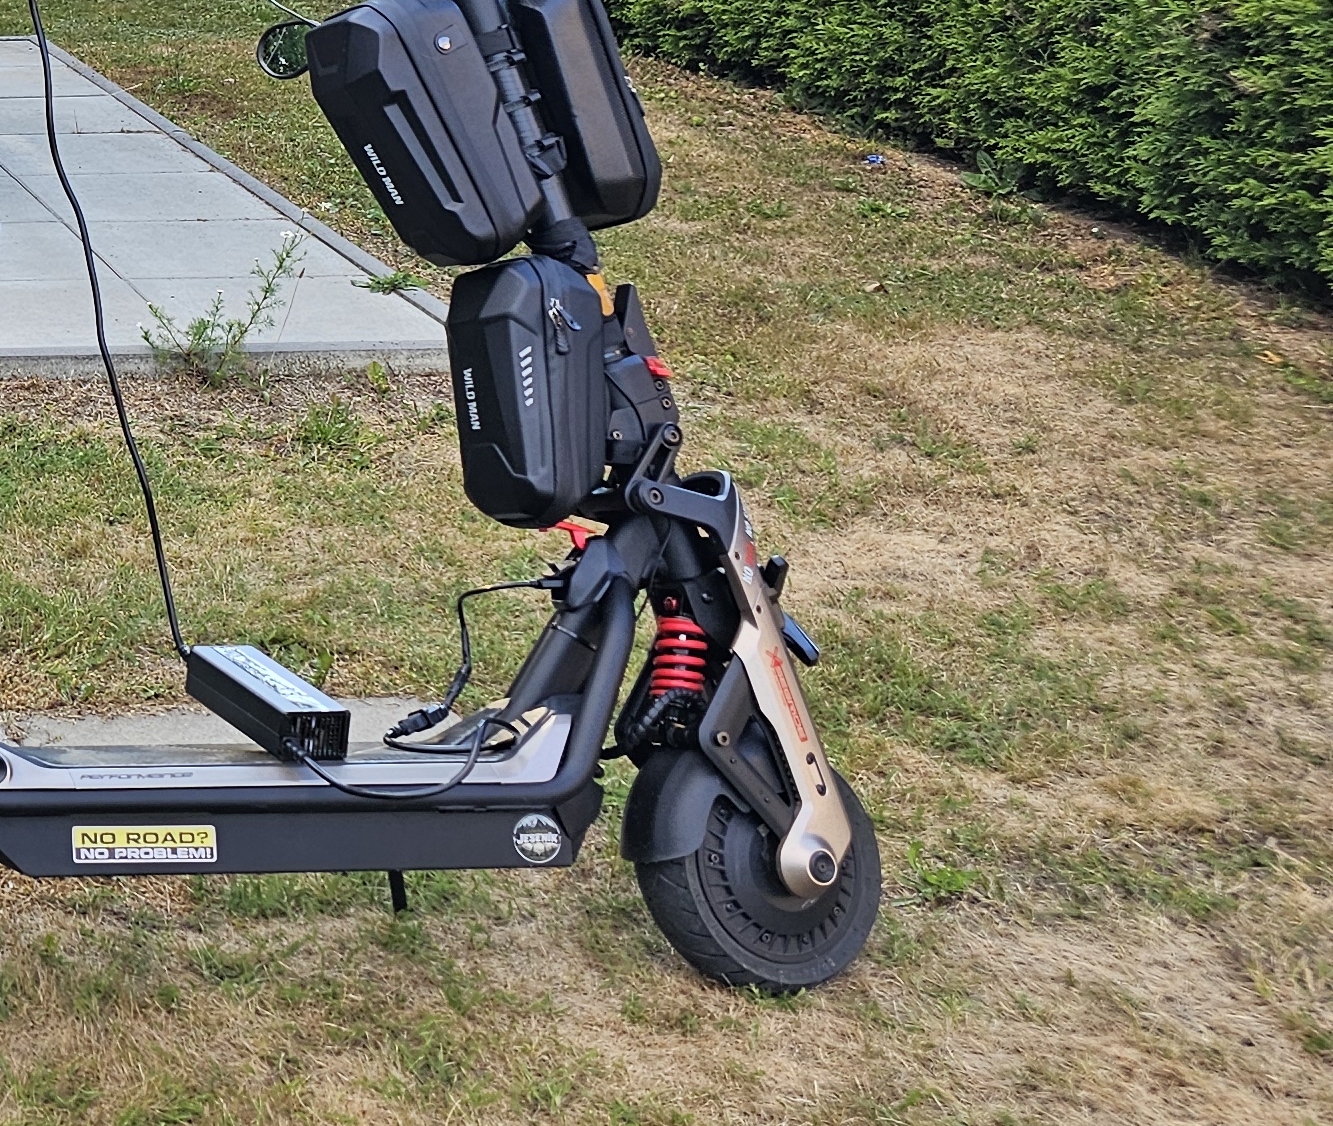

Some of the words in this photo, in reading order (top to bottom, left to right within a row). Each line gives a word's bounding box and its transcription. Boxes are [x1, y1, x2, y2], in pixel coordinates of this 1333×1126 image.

[364, 143, 387, 175] WILD
[381, 176, 404, 205] MAN
[463, 367, 476, 400] WILD
[467, 401, 481, 430] MAN
[81, 832, 116, 845] NO
[126, 831, 209, 845] ROAD?
[80, 847, 110, 860] NO
[114, 847, 212, 860] PROBLEM!
